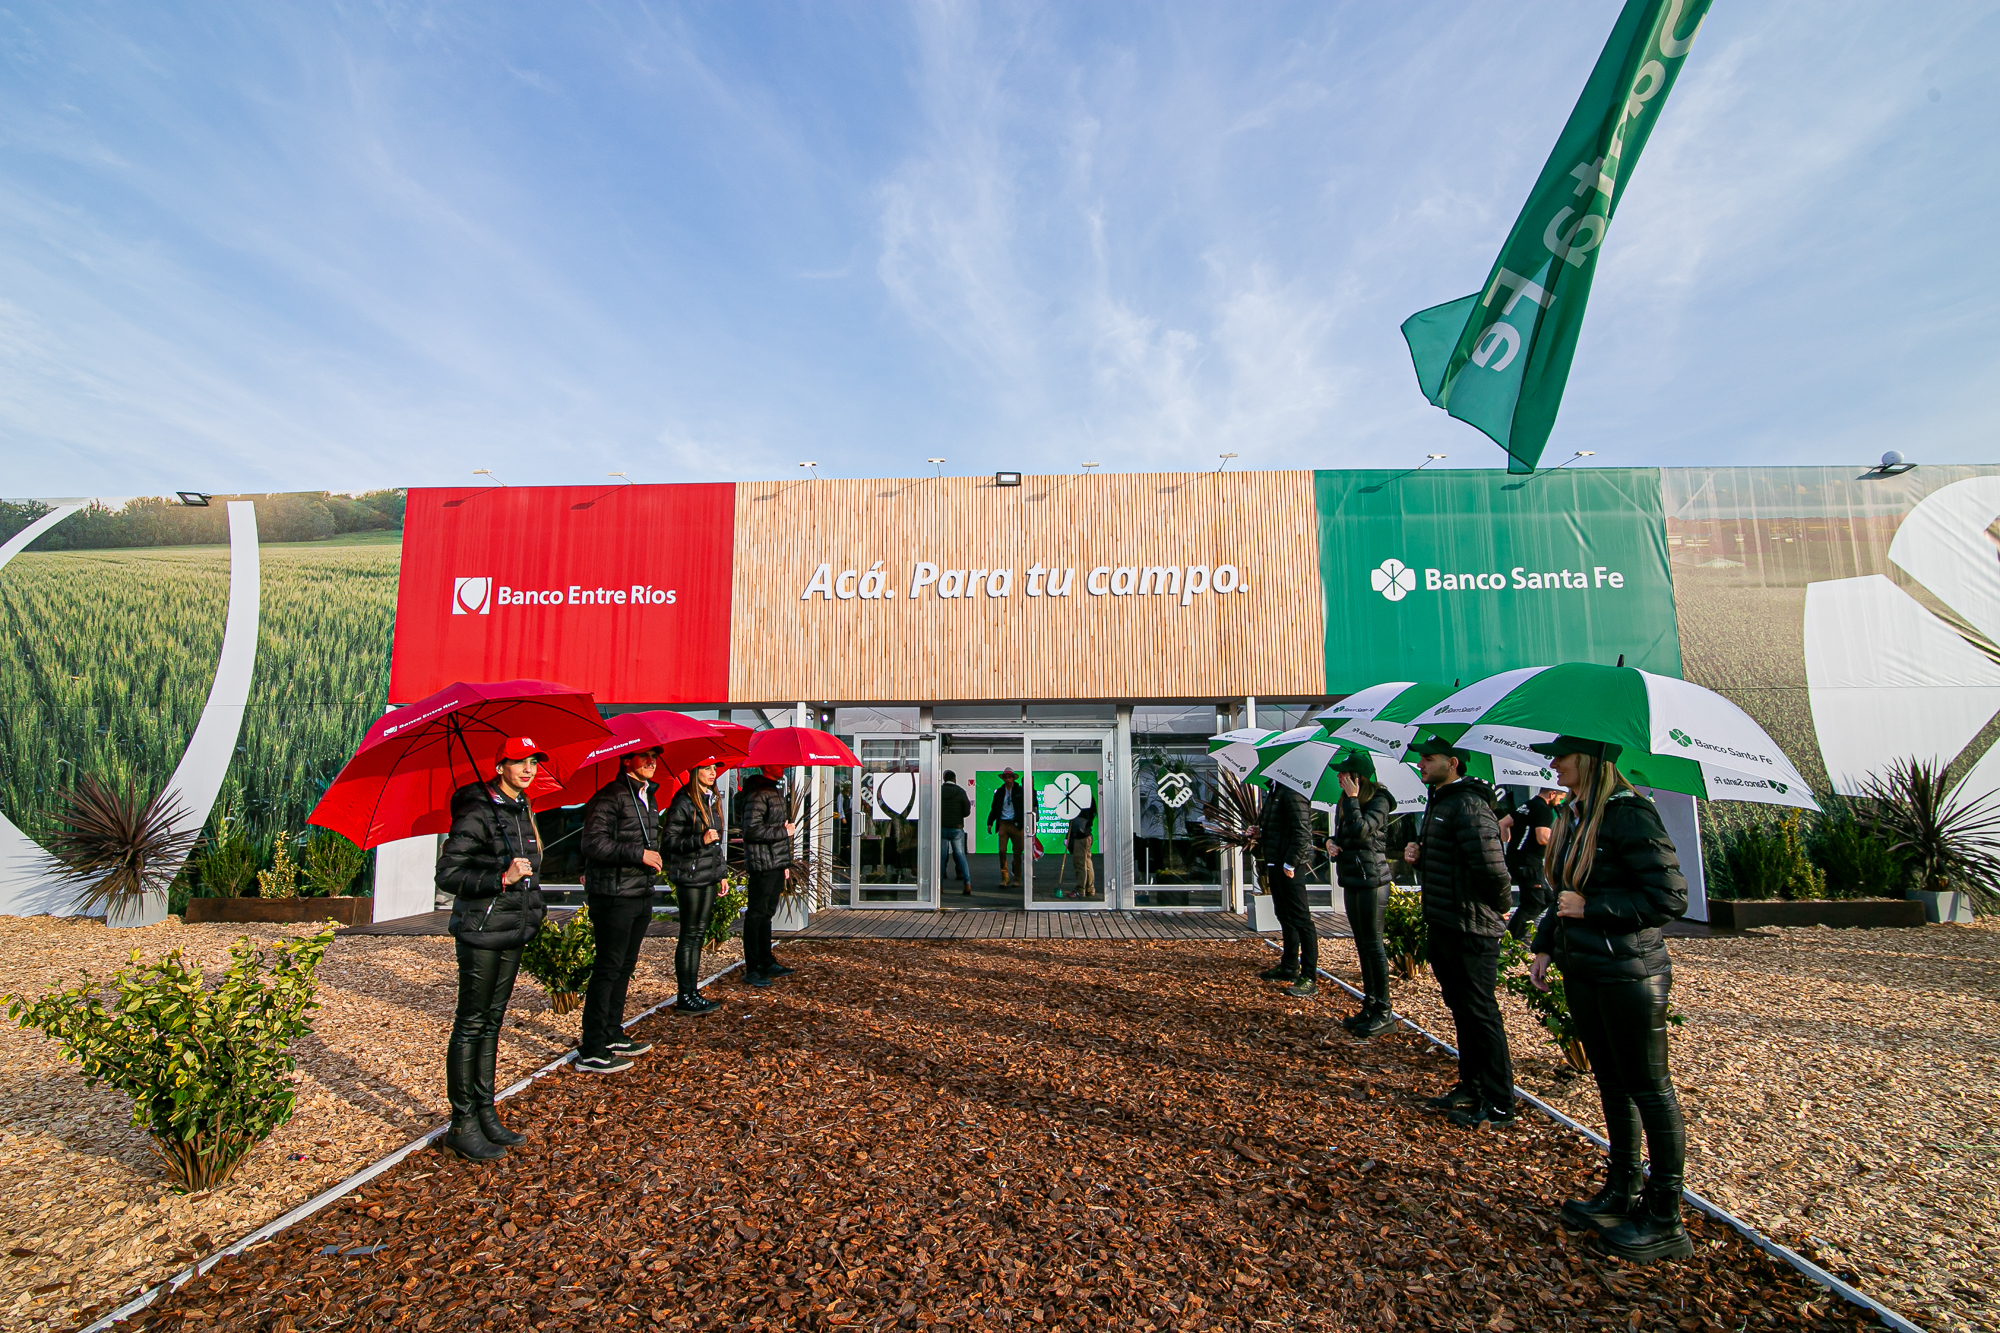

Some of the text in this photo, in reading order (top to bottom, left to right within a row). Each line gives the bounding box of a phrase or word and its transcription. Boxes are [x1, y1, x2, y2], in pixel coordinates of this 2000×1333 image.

[801, 560, 1250, 607] Acá. Para tu campo.
[1424, 566, 1624, 591] Banco Santa Fe
[497, 585, 677, 605] Banco Entre Ríos
[398, 717, 422, 729] Banco
[422, 707, 443, 719] Entre
[1694, 738, 1773, 765] Banco Santa Fe
